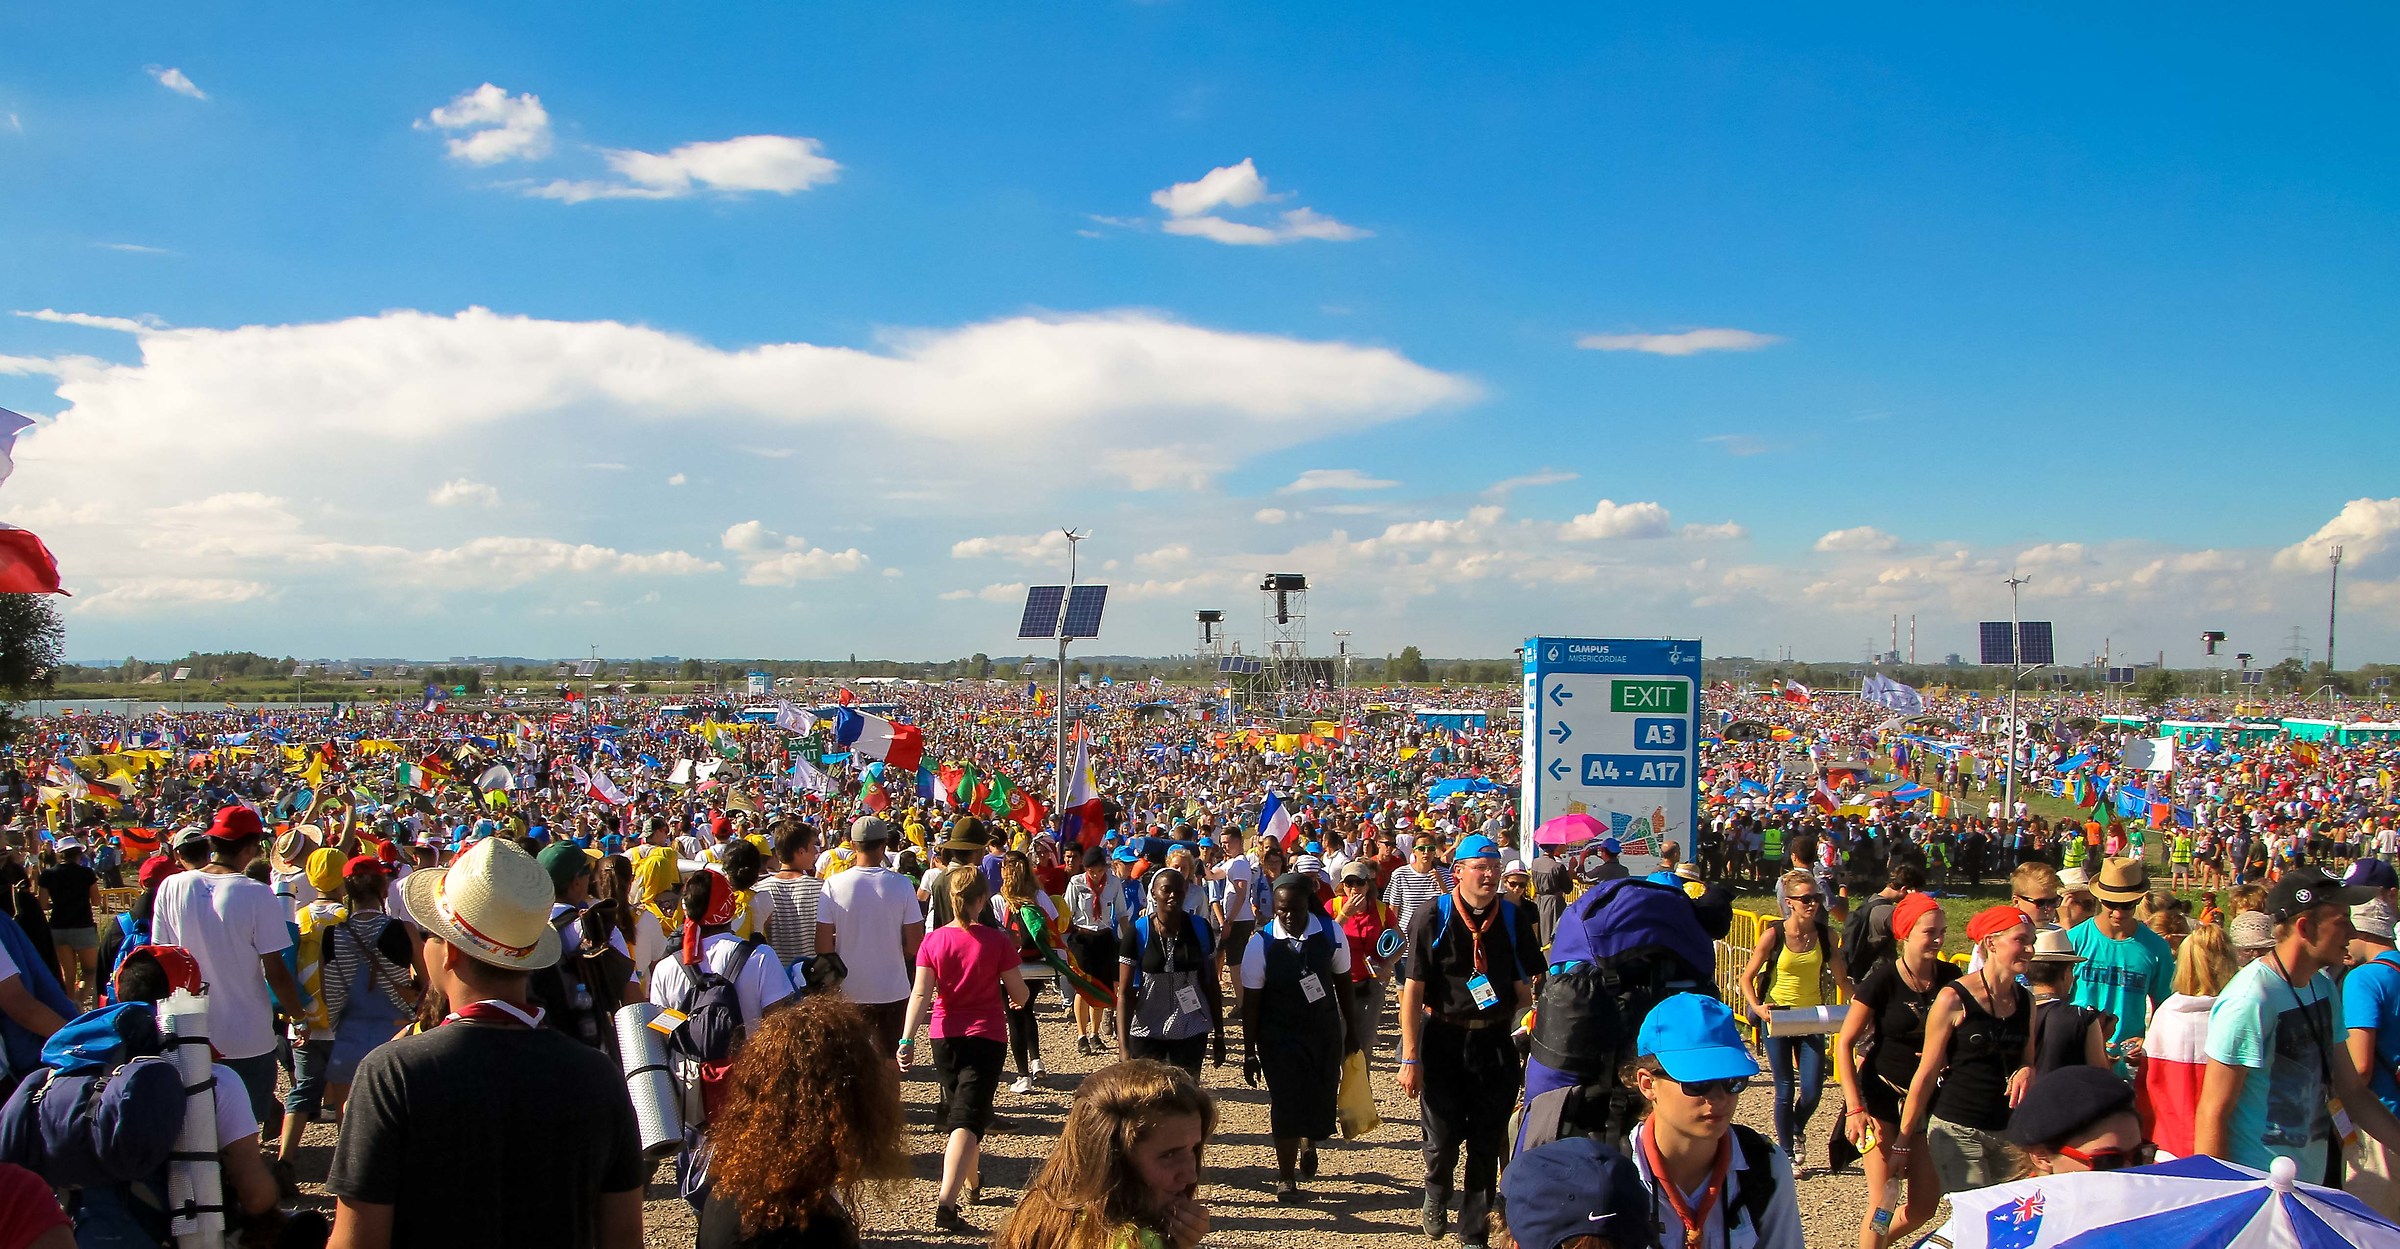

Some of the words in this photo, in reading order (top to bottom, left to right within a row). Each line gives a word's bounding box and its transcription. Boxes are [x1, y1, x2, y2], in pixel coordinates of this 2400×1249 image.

[1568, 644, 1610, 654] CAMPUS
[1568, 654, 1627, 663] MISERICORDIAE
[1623, 686, 1676, 707] EXIT
[1644, 724, 1676, 744] A3
[788, 735, 816, 748] A4-2
[788, 748, 818, 761] EXIT
[1587, 760, 1620, 781] A4
[1639, 761, 1680, 781] A17
